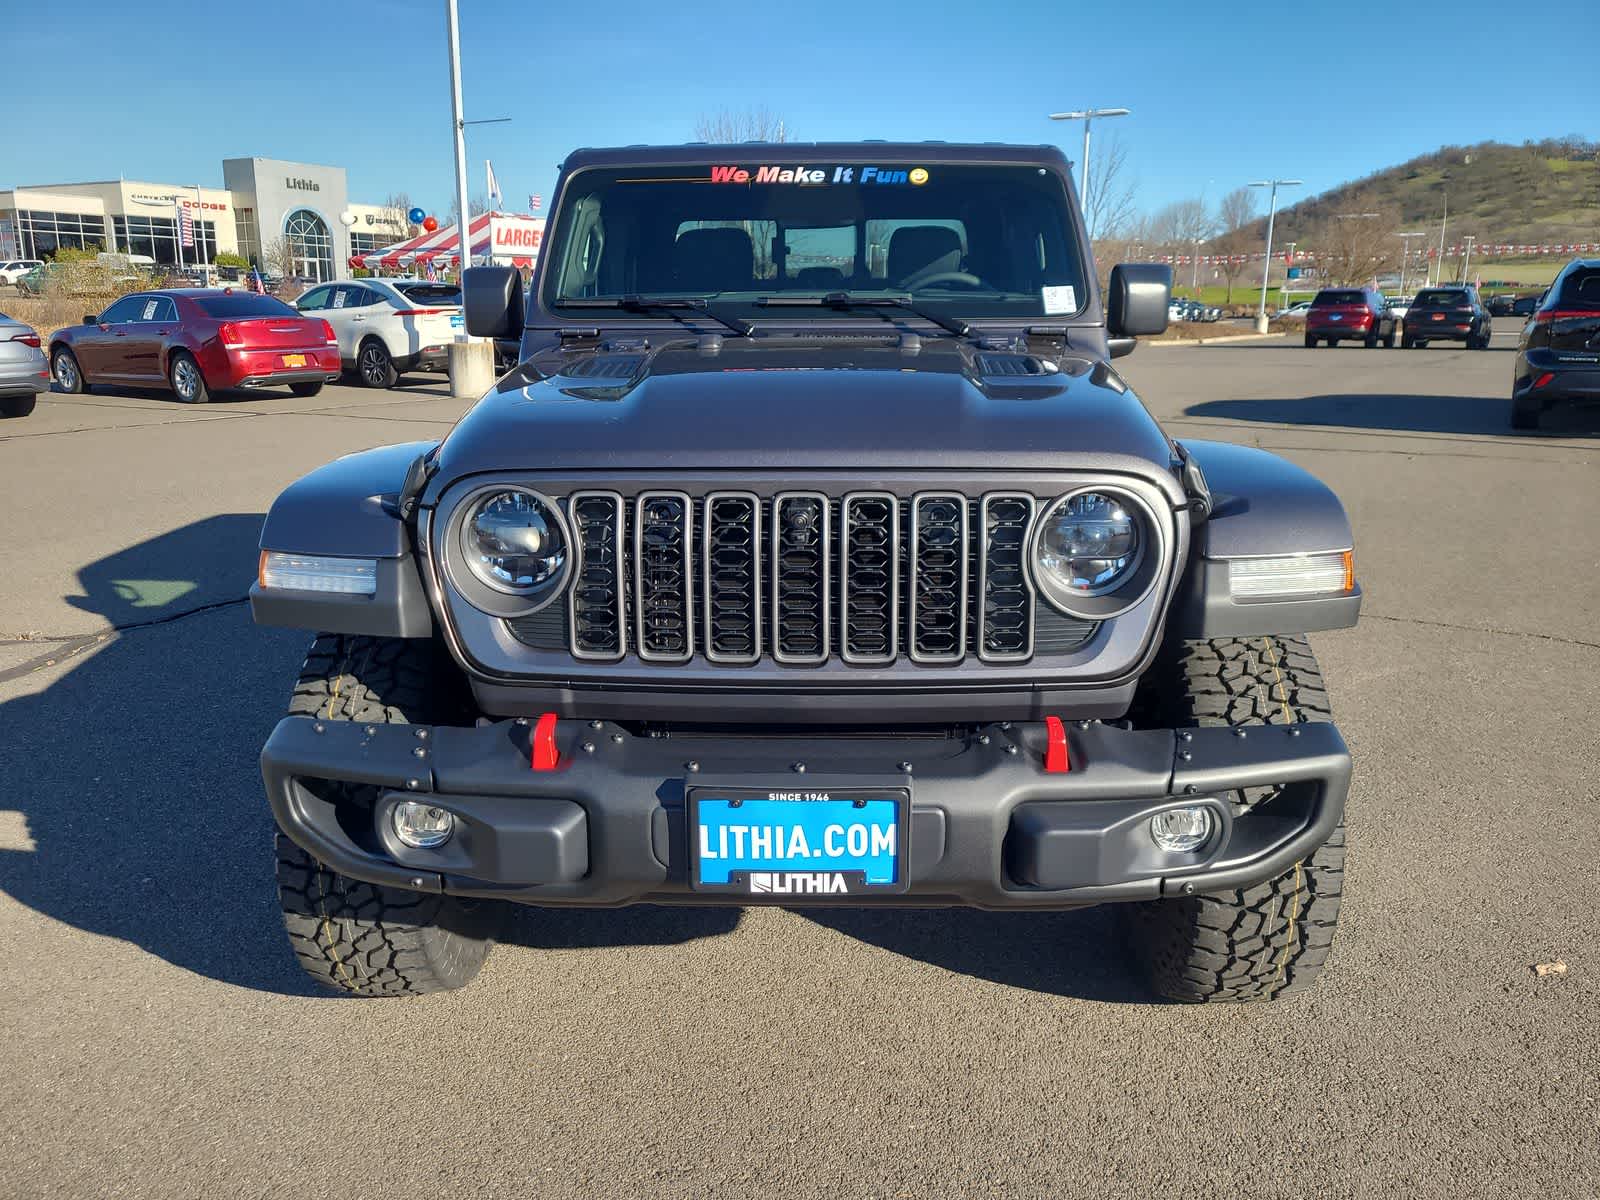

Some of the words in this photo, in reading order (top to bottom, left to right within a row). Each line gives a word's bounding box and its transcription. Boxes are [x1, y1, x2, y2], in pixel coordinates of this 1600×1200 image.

[710, 166, 749, 184] We
[756, 166, 825, 184] Make
[832, 166, 854, 184] It
[859, 167, 907, 184] Fun
[286, 177, 320, 192] Lithia
[182, 200, 227, 211] DODGE
[768, 793, 802, 802] SINCE
[804, 793, 830, 802] 1946
[699, 824, 897, 860] LITHIA.COM
[772, 872, 849, 894] LITHIA
